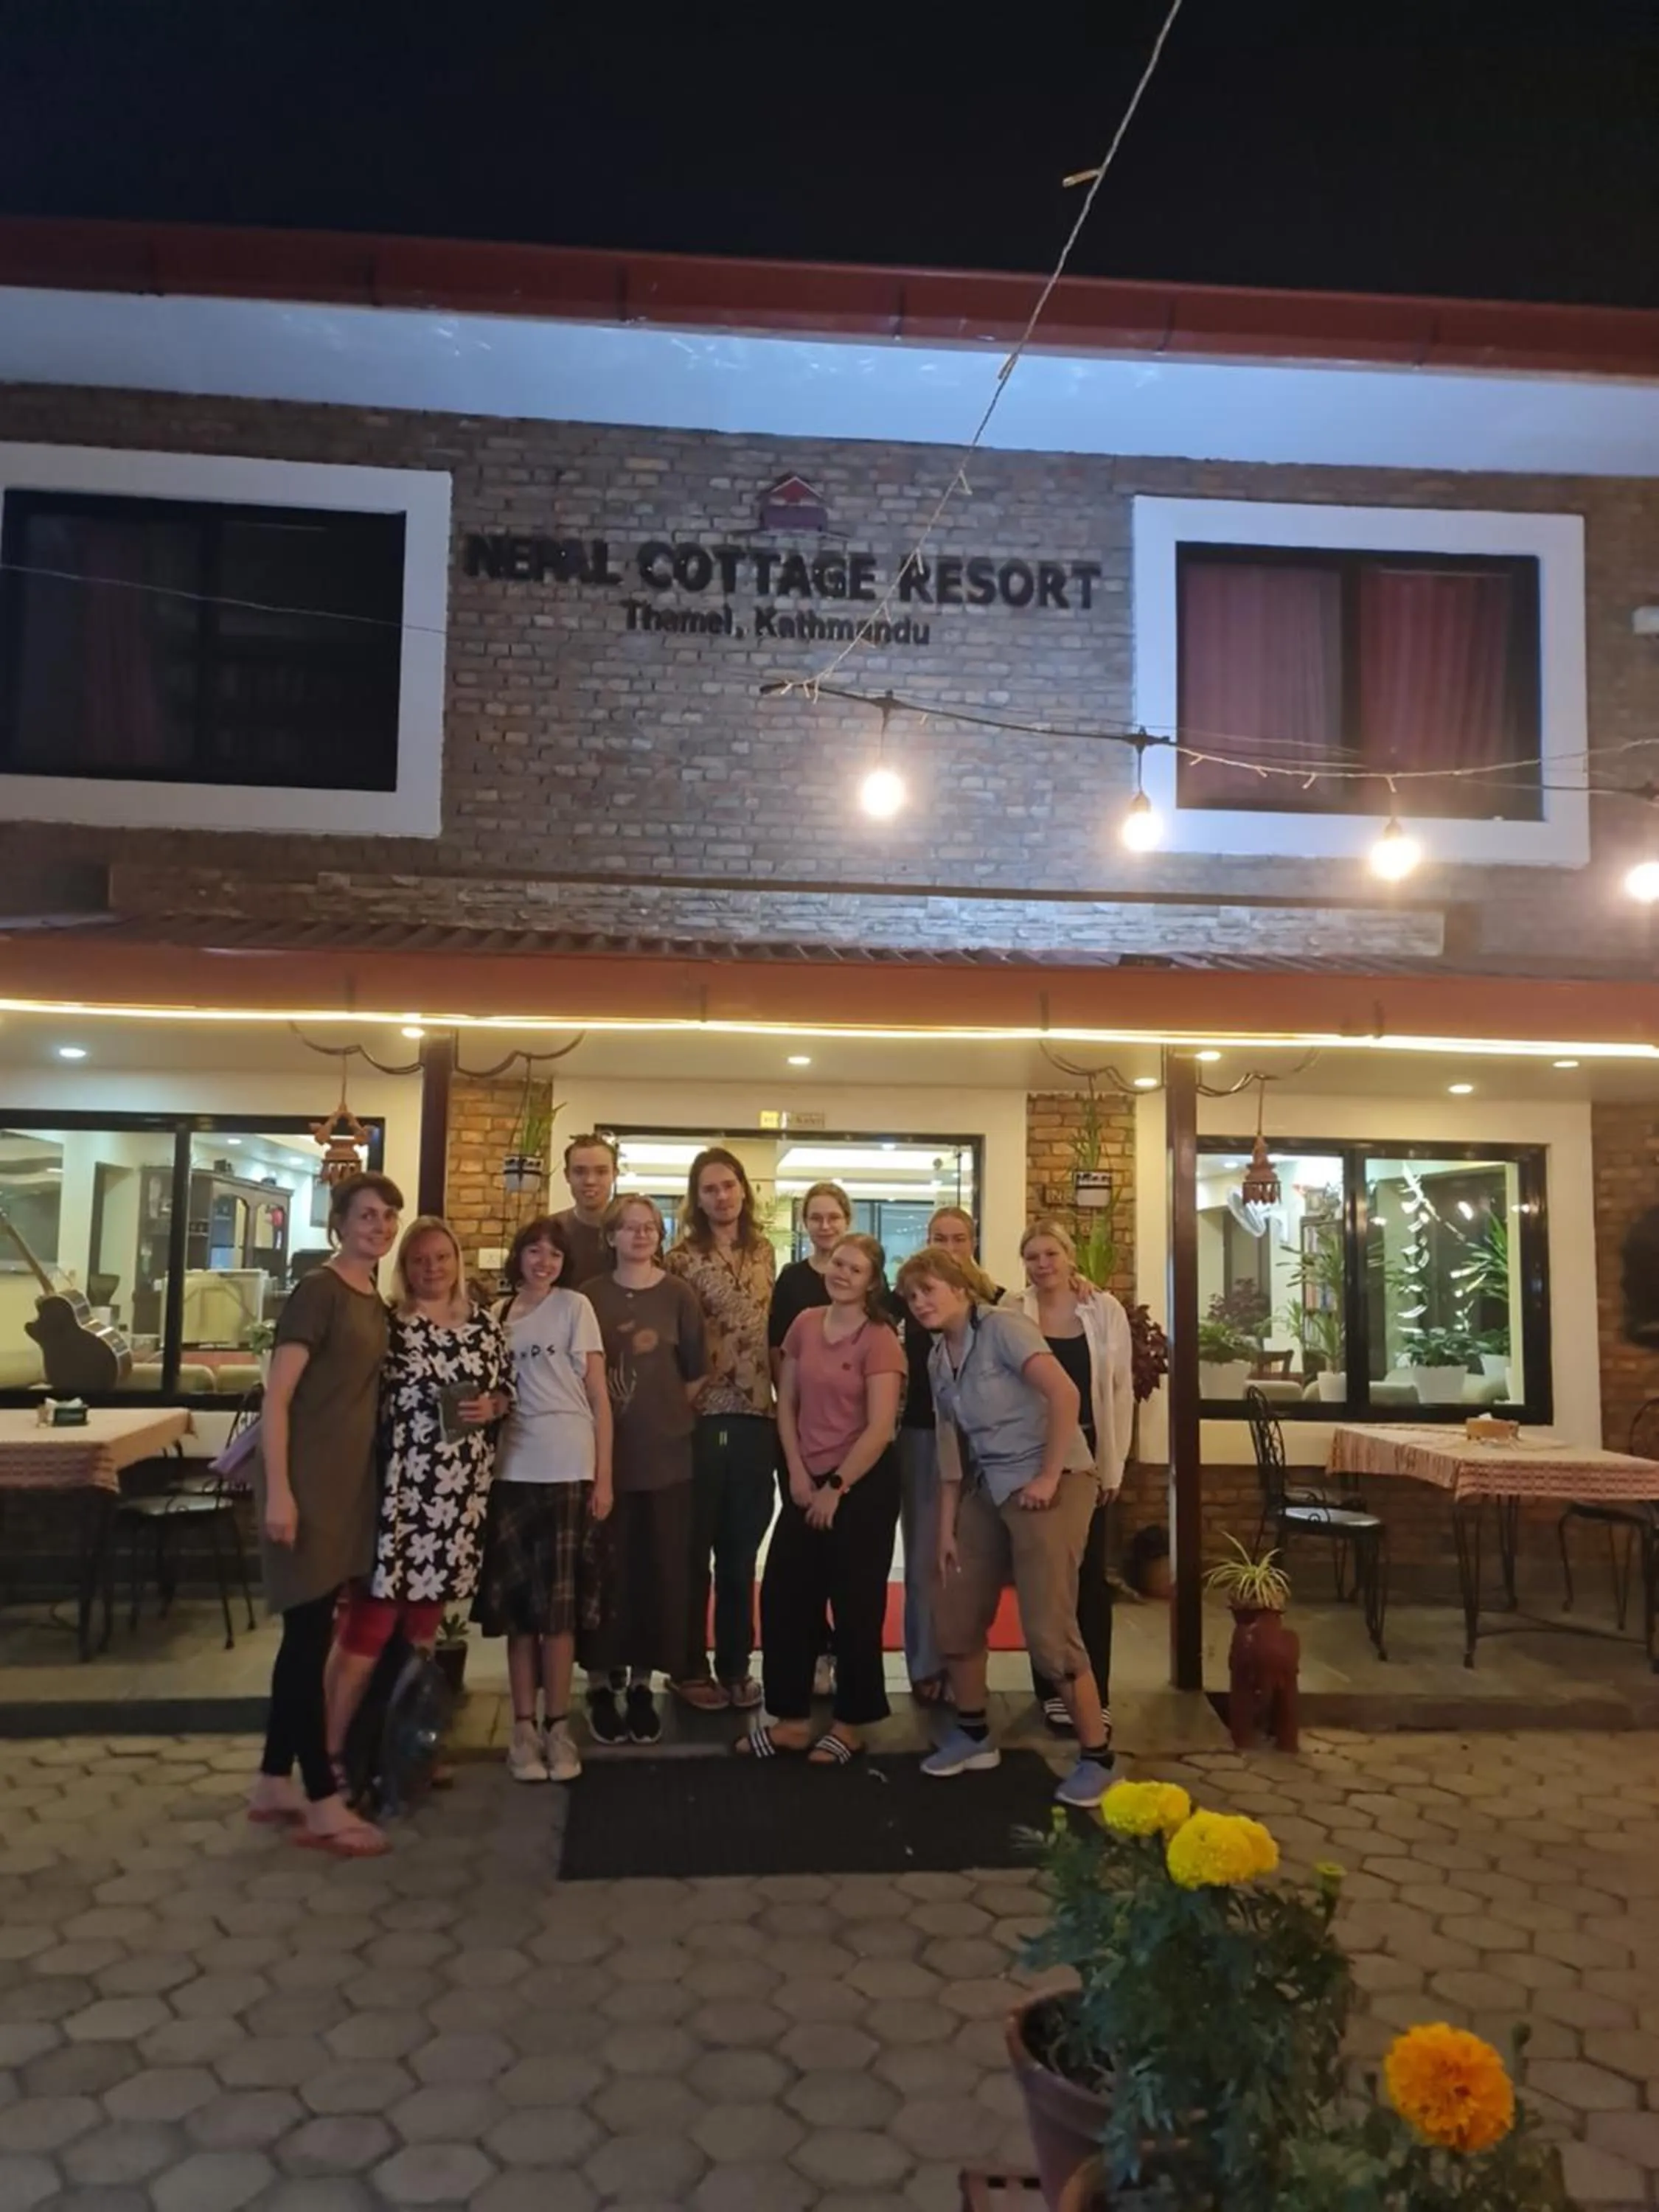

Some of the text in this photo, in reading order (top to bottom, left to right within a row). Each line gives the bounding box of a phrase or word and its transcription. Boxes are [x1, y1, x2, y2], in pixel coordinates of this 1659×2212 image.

[464, 535, 1102, 610] NEPAL COTTAGE RESORT
[621, 599, 930, 646] Thamel, Kathmandu
